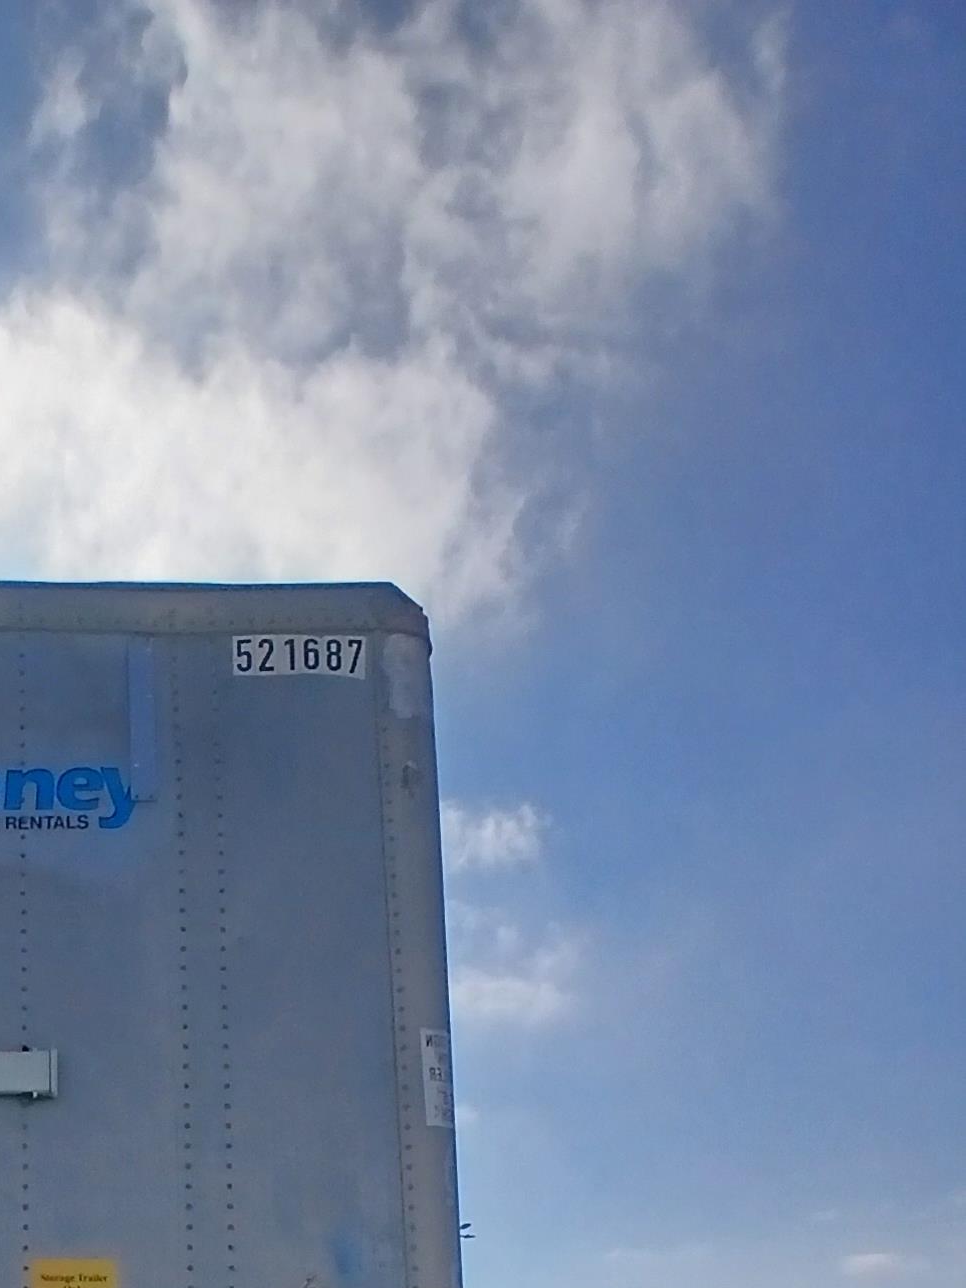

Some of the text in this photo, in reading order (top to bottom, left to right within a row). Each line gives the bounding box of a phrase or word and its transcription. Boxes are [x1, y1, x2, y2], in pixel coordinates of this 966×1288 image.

[236, 638, 363, 674] 521687
[5, 815, 90, 831] RENTALS
[41, 1273, 108, 1284] Storage Trailer
